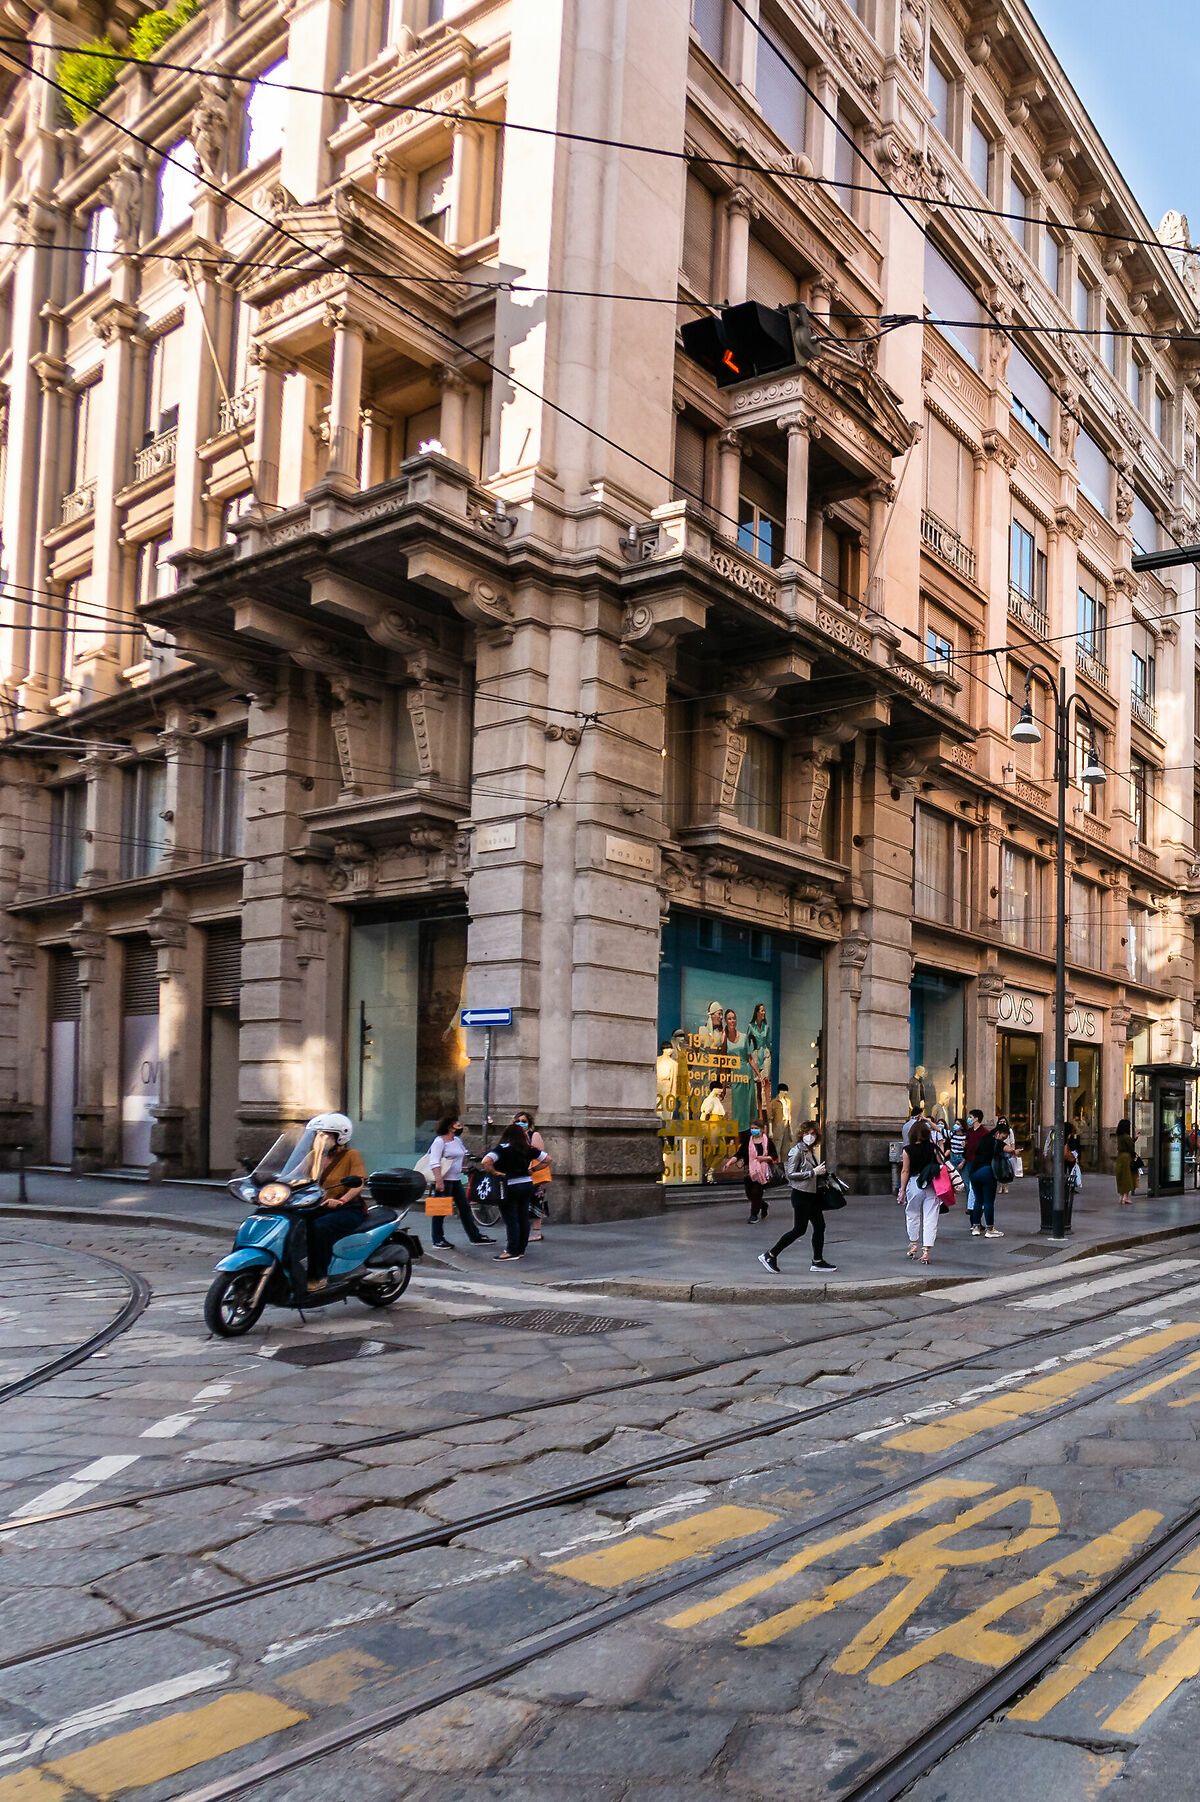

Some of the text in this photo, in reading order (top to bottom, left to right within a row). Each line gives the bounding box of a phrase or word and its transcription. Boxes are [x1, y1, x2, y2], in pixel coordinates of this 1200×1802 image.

[611, 848, 651, 864] TORINO
[997, 993, 1034, 1025] OVS
[1068, 1008, 1096, 1037] OVS
[688, 1033, 722, 1050] 1972.
[687, 1052, 737, 1067] OVS apre
[141, 1061, 160, 1084] OV
[687, 1070, 750, 1084] per la prima
[688, 1085, 710, 1097] volt
[663, 1143, 679, 1155] er
[664, 1162, 698, 1177] olta.
